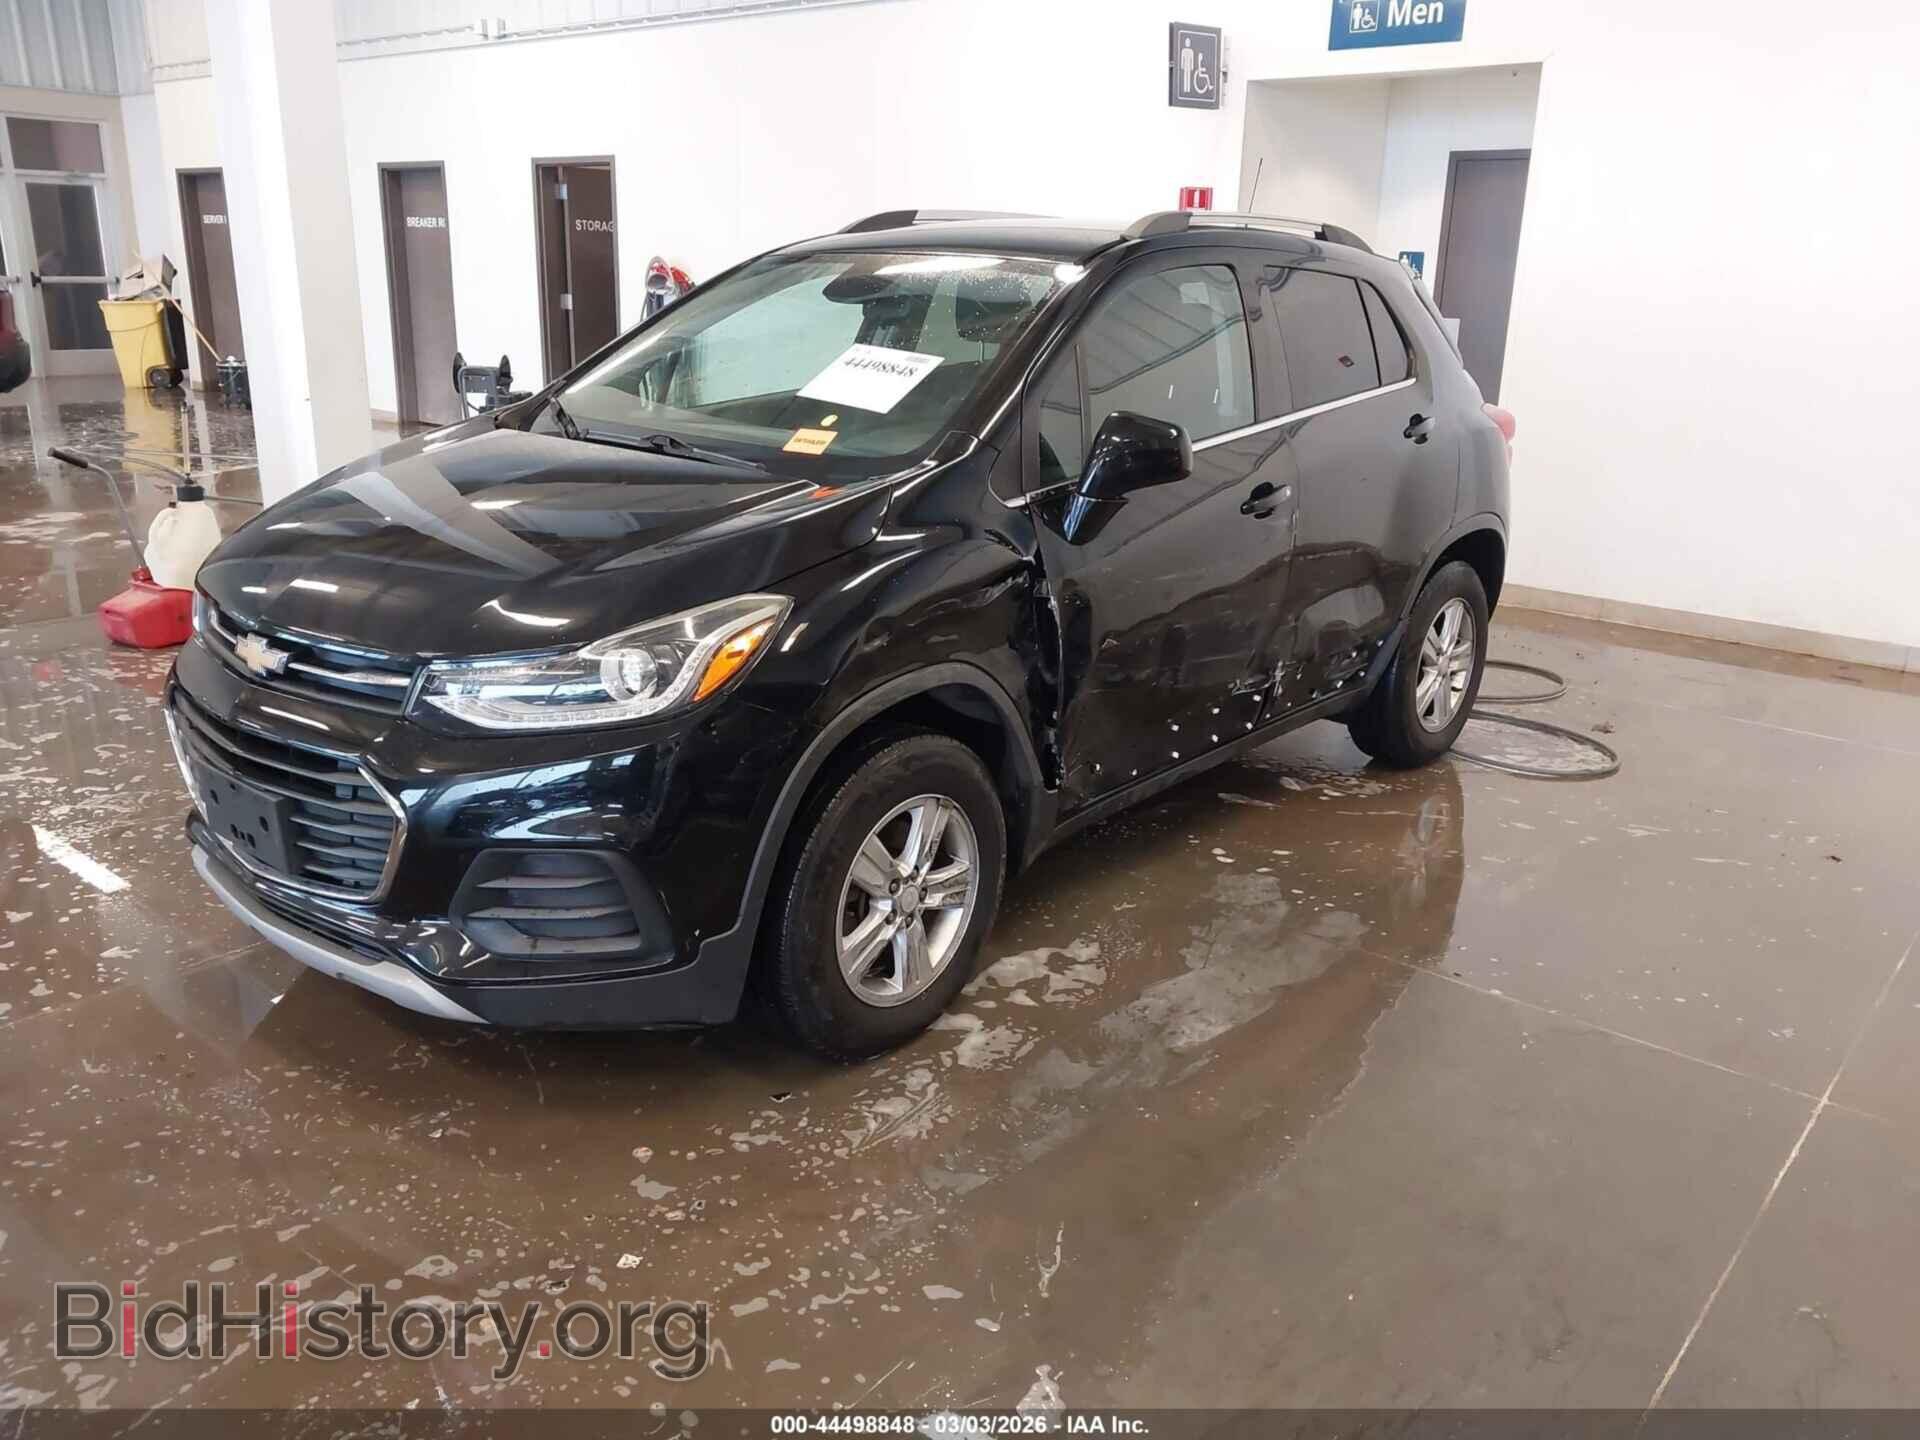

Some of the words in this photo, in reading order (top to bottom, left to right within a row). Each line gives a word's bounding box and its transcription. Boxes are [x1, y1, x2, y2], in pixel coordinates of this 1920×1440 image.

[1386, 0, 1445, 28] Men
[406, 216, 437, 228] BREAKER
[844, 357, 919, 377] 44498848
